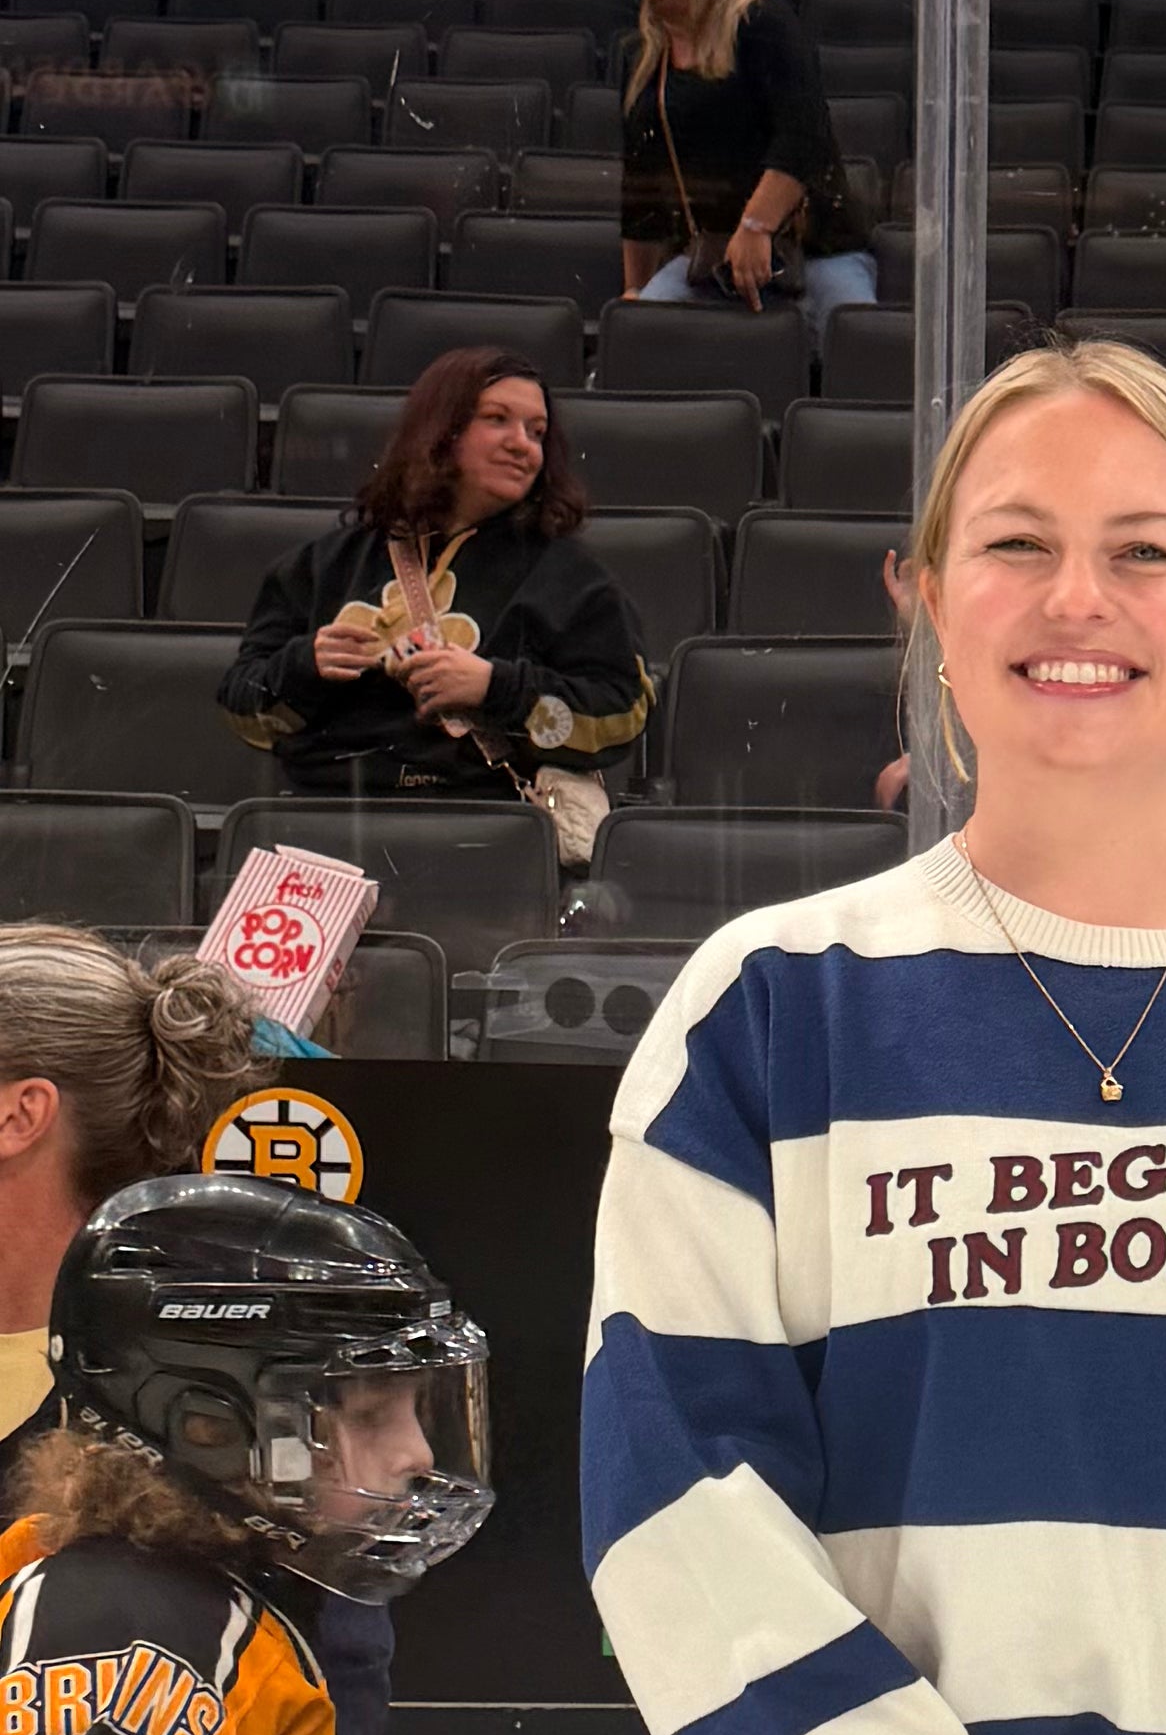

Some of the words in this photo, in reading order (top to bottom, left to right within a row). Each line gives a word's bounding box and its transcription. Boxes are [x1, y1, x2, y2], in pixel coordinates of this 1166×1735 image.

[240, 908, 304, 946] POP
[233, 942, 317, 980] CORN
[865, 1163, 953, 1238] IT
[926, 1227, 1028, 1306] IN
